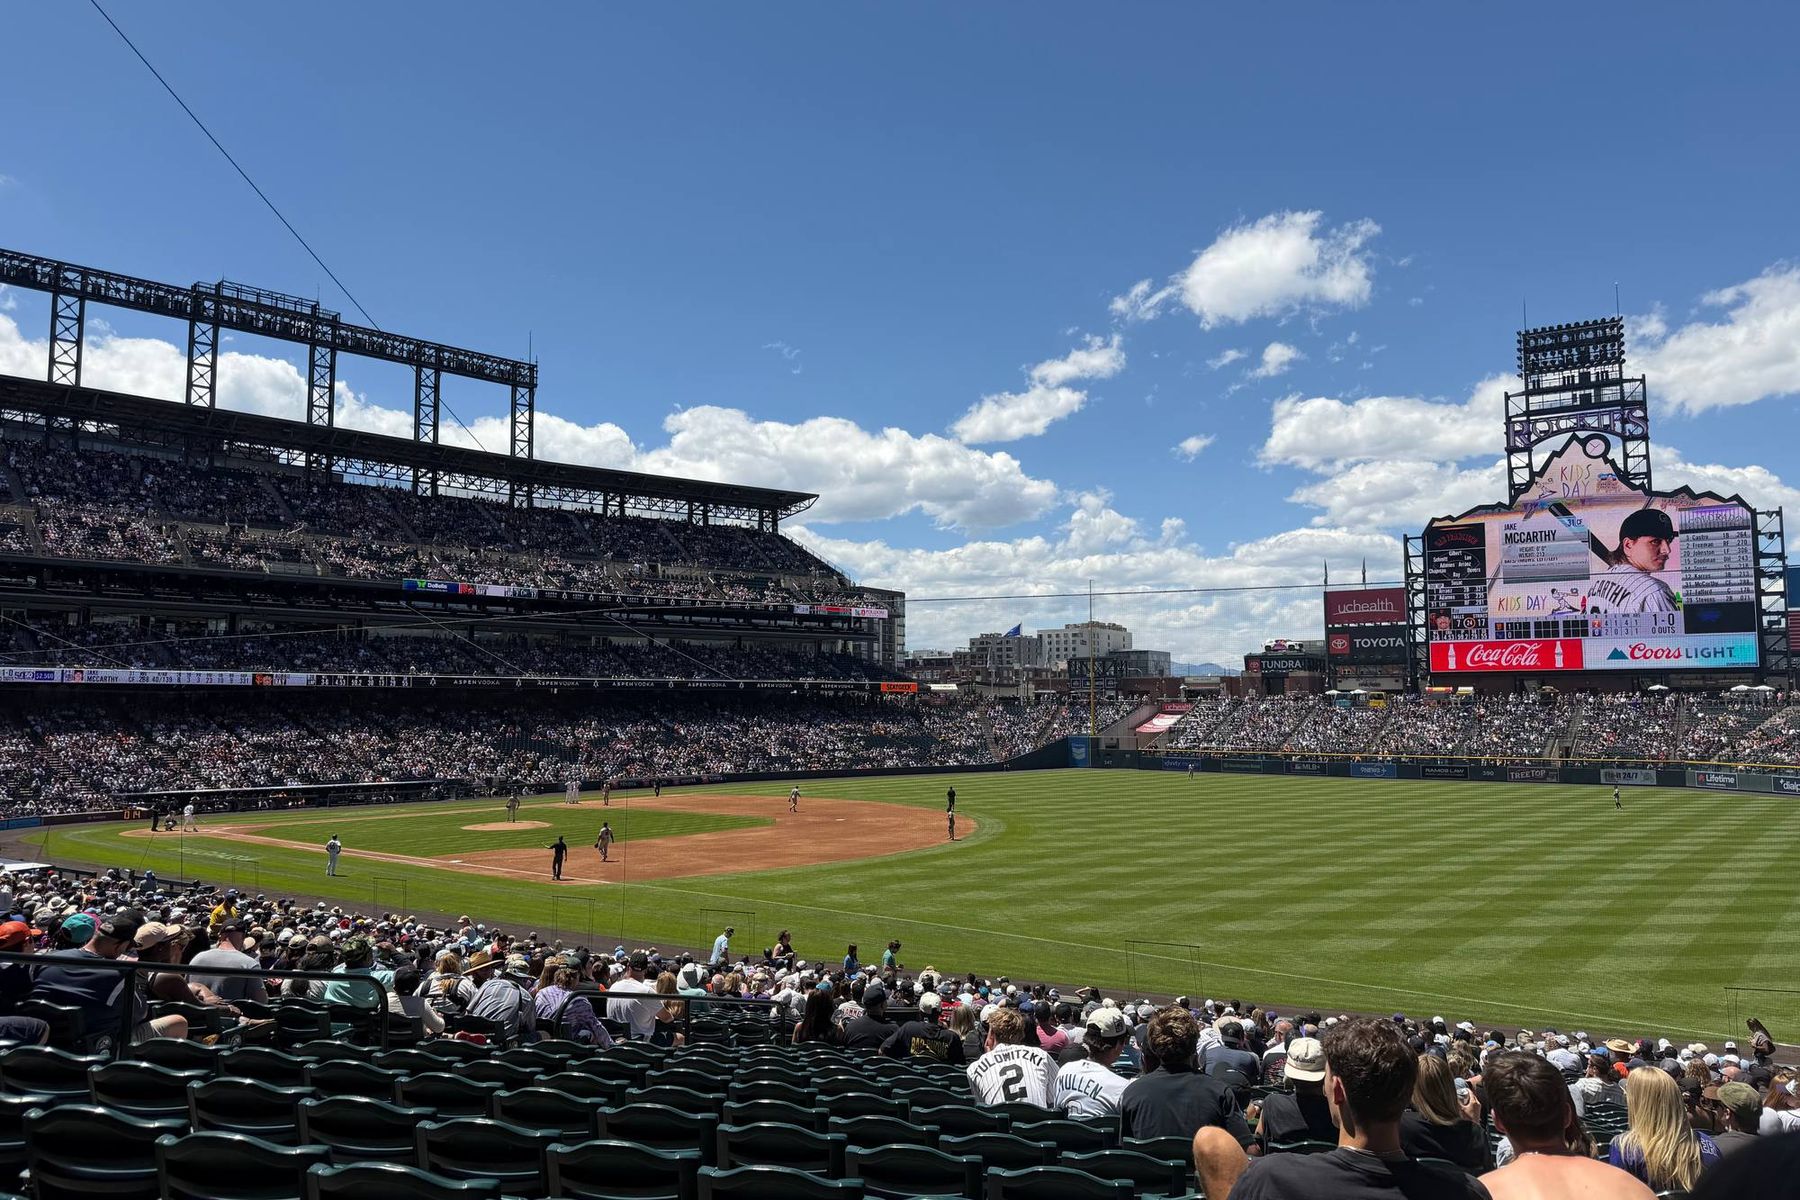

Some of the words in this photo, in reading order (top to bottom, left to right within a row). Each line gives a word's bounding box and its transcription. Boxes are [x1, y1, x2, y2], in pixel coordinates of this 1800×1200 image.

[1508, 407, 1648, 447] ROCKIES
[1561, 464, 1591, 482] KIDS
[1562, 481, 1590, 497] DAY
[1504, 522, 1517, 531] JAKE
[1504, 529, 1557, 545] MCCARTHY
[1337, 597, 1394, 614] uchealth
[1498, 596, 1521, 611] KIDS
[1526, 595, 1548, 610] DAY
[1477, 618, 1486, 627] 17
[1658, 626, 1676, 634] OUTS
[1353, 638, 1405, 648] TOYOTA
[1466, 643, 1542, 667] Coca-Cola
[1629, 642, 1682, 660] Coors
[1685, 646, 1735, 659] LIGHT
[1261, 660, 1302, 669] TUNDRA
[1510, 769, 1546, 779] TREETOP
[1623, 771, 1638, 779] 24/7
[1705, 773, 1735, 784] Lifetime
[974, 1049, 1044, 1079] TULOWITZKI
[999, 1064, 1028, 1102] 2
